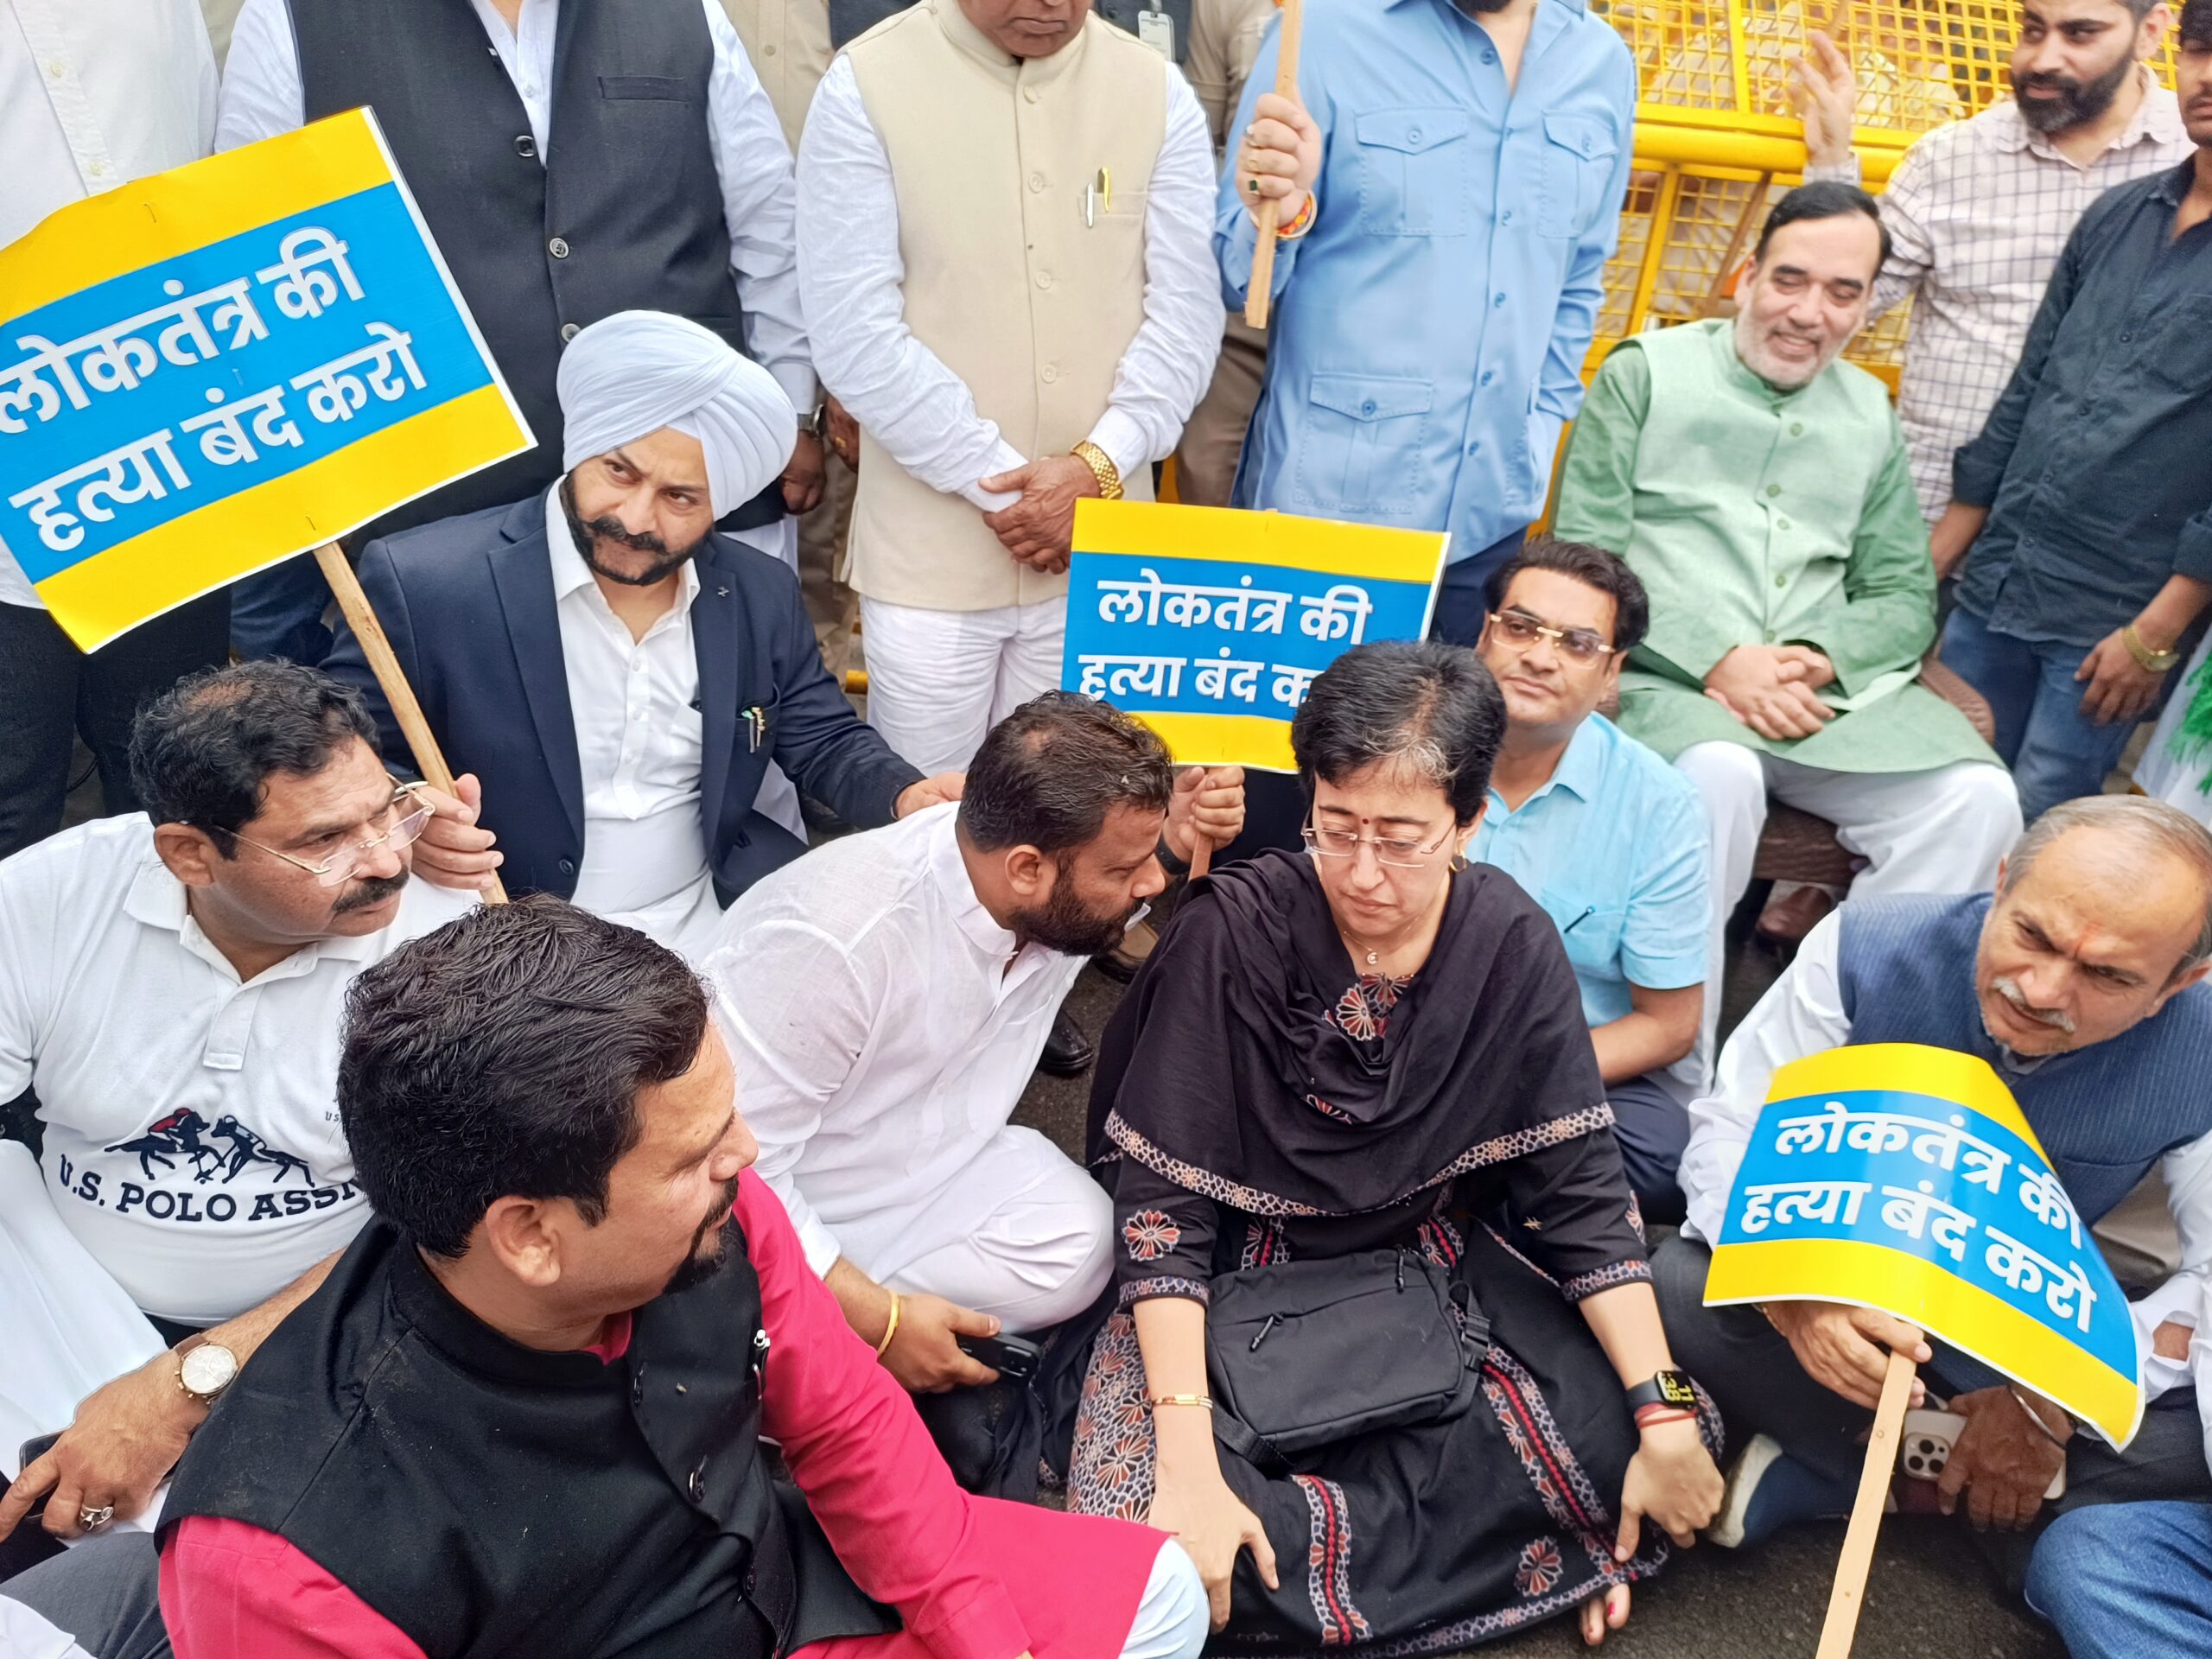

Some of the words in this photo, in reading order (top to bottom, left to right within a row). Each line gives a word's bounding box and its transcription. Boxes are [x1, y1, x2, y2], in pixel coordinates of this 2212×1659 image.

[0, 278, 270, 435] लोकतंत्र
[254, 225, 366, 319] की
[7, 427, 193, 553] हत्या
[180, 385, 305, 467] बंद
[289, 321, 428, 423] करो
[1077, 654, 1187, 702] हत्या
[1194, 645, 1265, 702] बंद
[1096, 568, 1293, 635] लोकतंत्र
[1299, 584, 1373, 645] की
[60, 1154, 105, 1206] U.S.
[115, 1181, 237, 1222] POLO
[1775, 1102, 2012, 1195] लोकतंत्र
[2018, 1162, 2082, 1250] की
[1739, 1180, 1872, 1234] हत्या
[1879, 1180, 1978, 1262] बंद
[1984, 1224, 2098, 1334] करो
